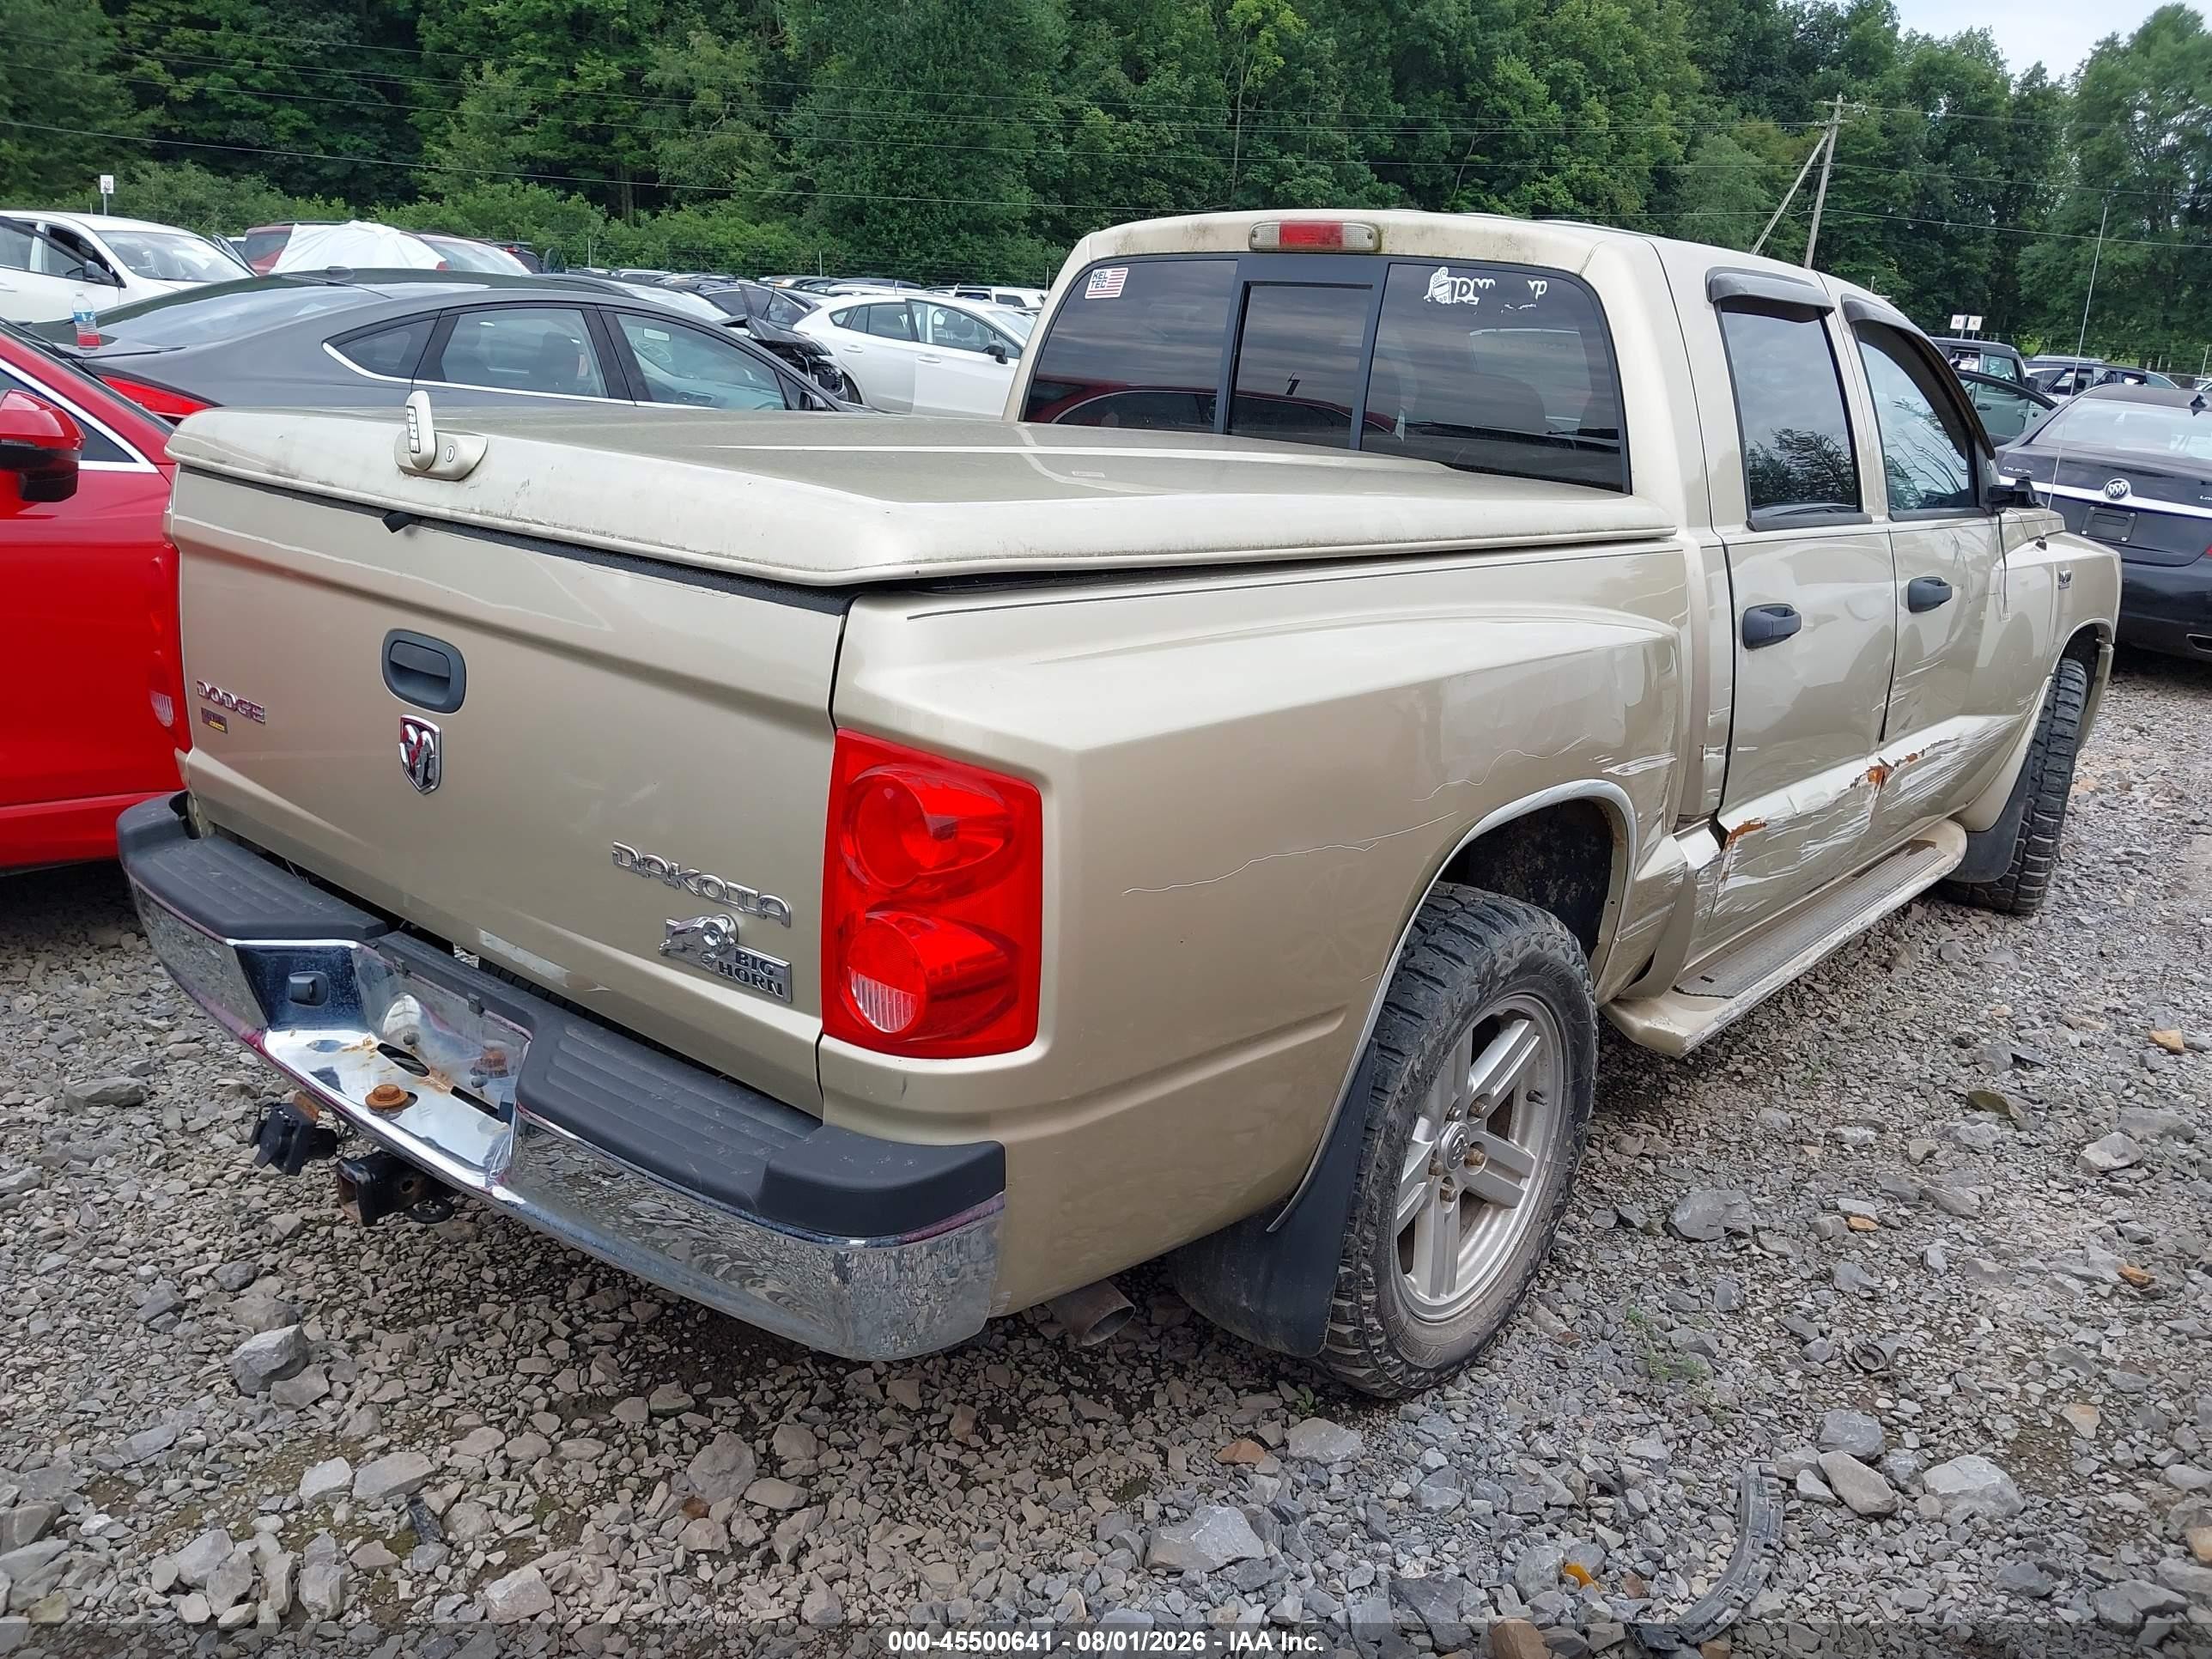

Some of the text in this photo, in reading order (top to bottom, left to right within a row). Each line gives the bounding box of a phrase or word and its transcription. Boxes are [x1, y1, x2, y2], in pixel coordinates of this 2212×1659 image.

[1091, 280, 1107, 289] TEC
[1092, 270, 1109, 280] KEL
[2003, 466, 2034, 475] BUICK
[196, 679, 266, 726] DODGE
[611, 841, 792, 927] DAKOTA
[734, 950, 775, 977] BIG
[718, 961, 785, 998] HORN
